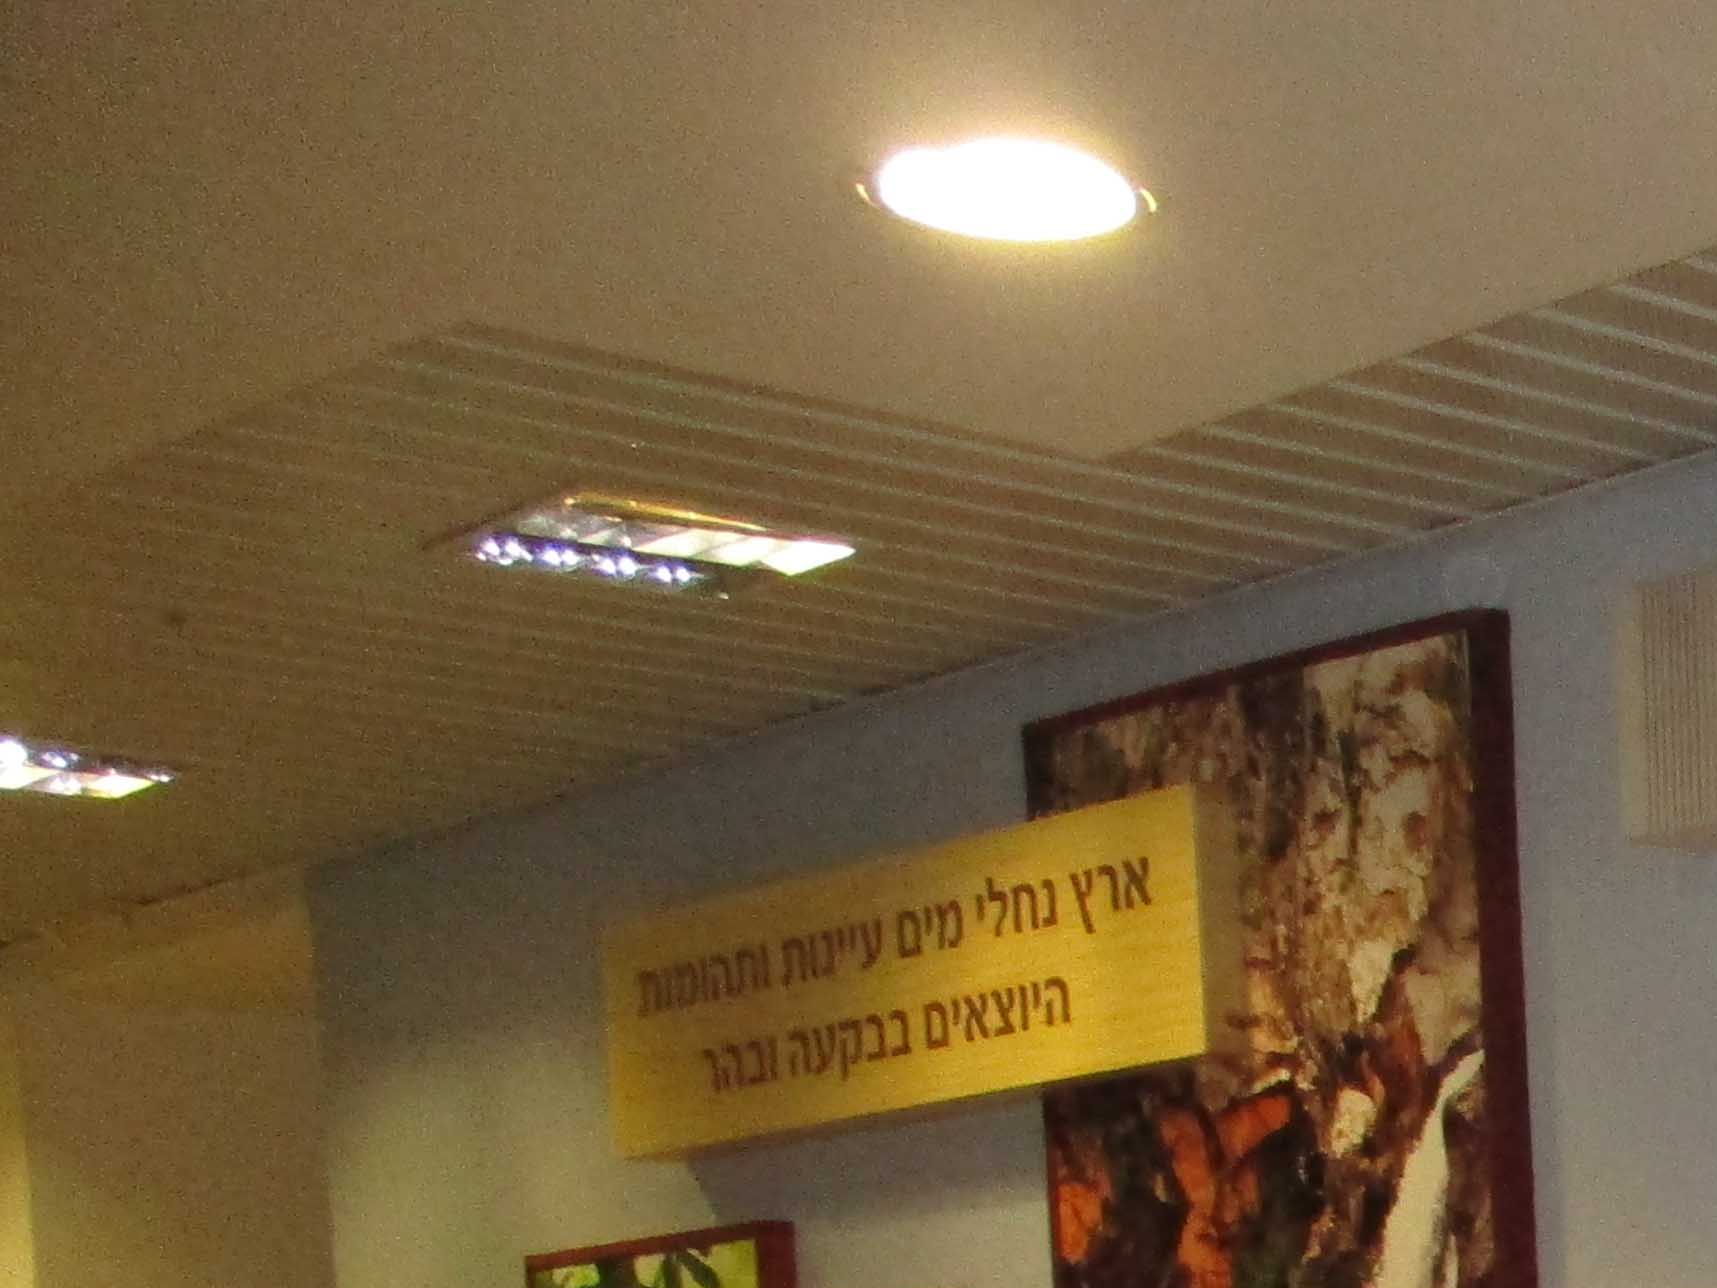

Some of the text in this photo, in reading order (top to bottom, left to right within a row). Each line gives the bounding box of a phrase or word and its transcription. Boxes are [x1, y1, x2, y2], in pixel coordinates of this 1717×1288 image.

[637, 856, 1152, 1017] ארץ נחלי מים עיינות ותהומות
[704, 976, 1071, 1093] היוצאים בבקעה ובהר
